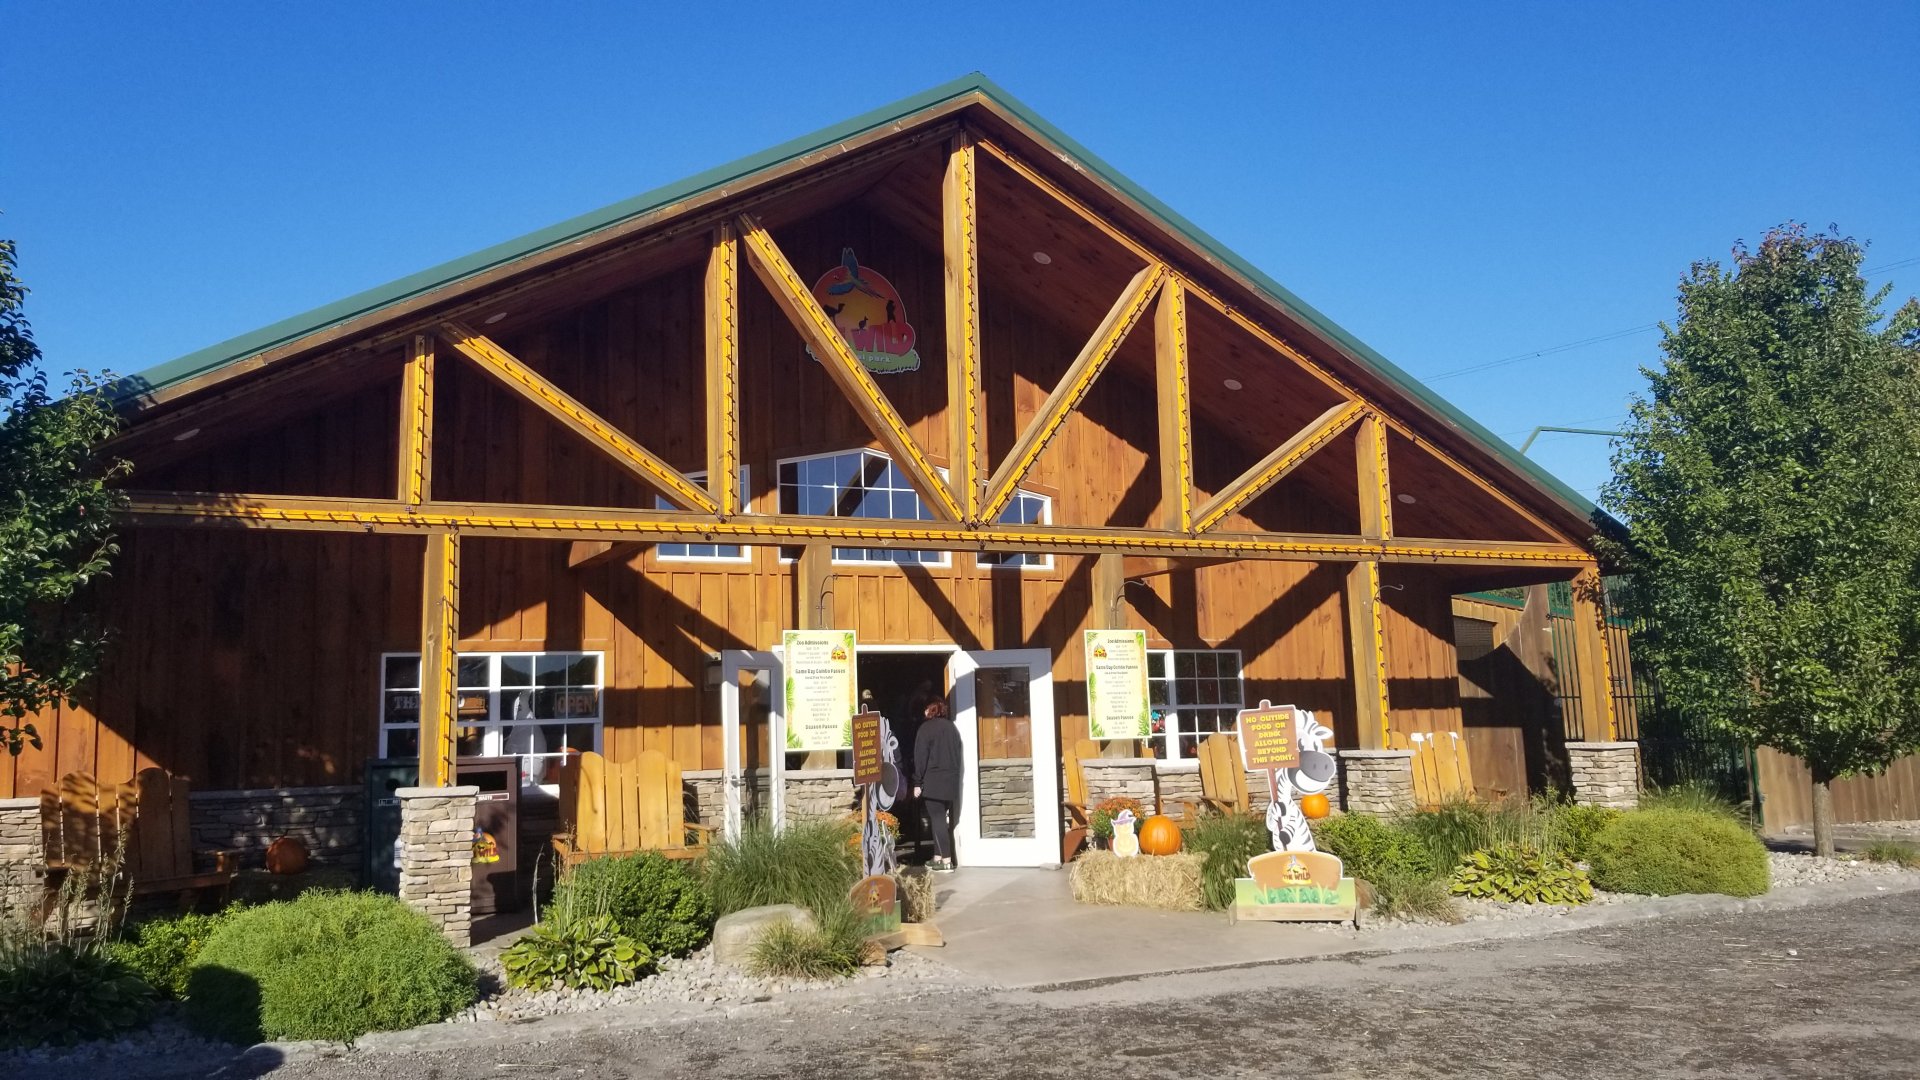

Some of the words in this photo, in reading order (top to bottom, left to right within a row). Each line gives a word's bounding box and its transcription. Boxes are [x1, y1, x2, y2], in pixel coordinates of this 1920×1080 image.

[557, 696, 593, 714] OPEN
[1245, 716, 1257, 724] NO
[1260, 713, 1290, 722] OUTSIDE
[854, 722, 861, 730] NO
[862, 720, 878, 729] OUTSIDE
[1251, 723, 1272, 731] FOOD
[857, 731, 869, 739] FOOD
[870, 729, 876, 737] OR
[1258, 730, 1281, 739] DRINK
[861, 739, 874, 748] DRINK
[1254, 737, 1289, 748] ALLOWED
[859, 748, 877, 757] ALLOWED
[1257, 746, 1287, 755] BEYOND
[860, 757, 876, 766] BEYOND
[1252, 756, 1268, 764] THIS
[1270, 754, 1295, 763] POINT.
[857, 768, 867, 777] THIS
